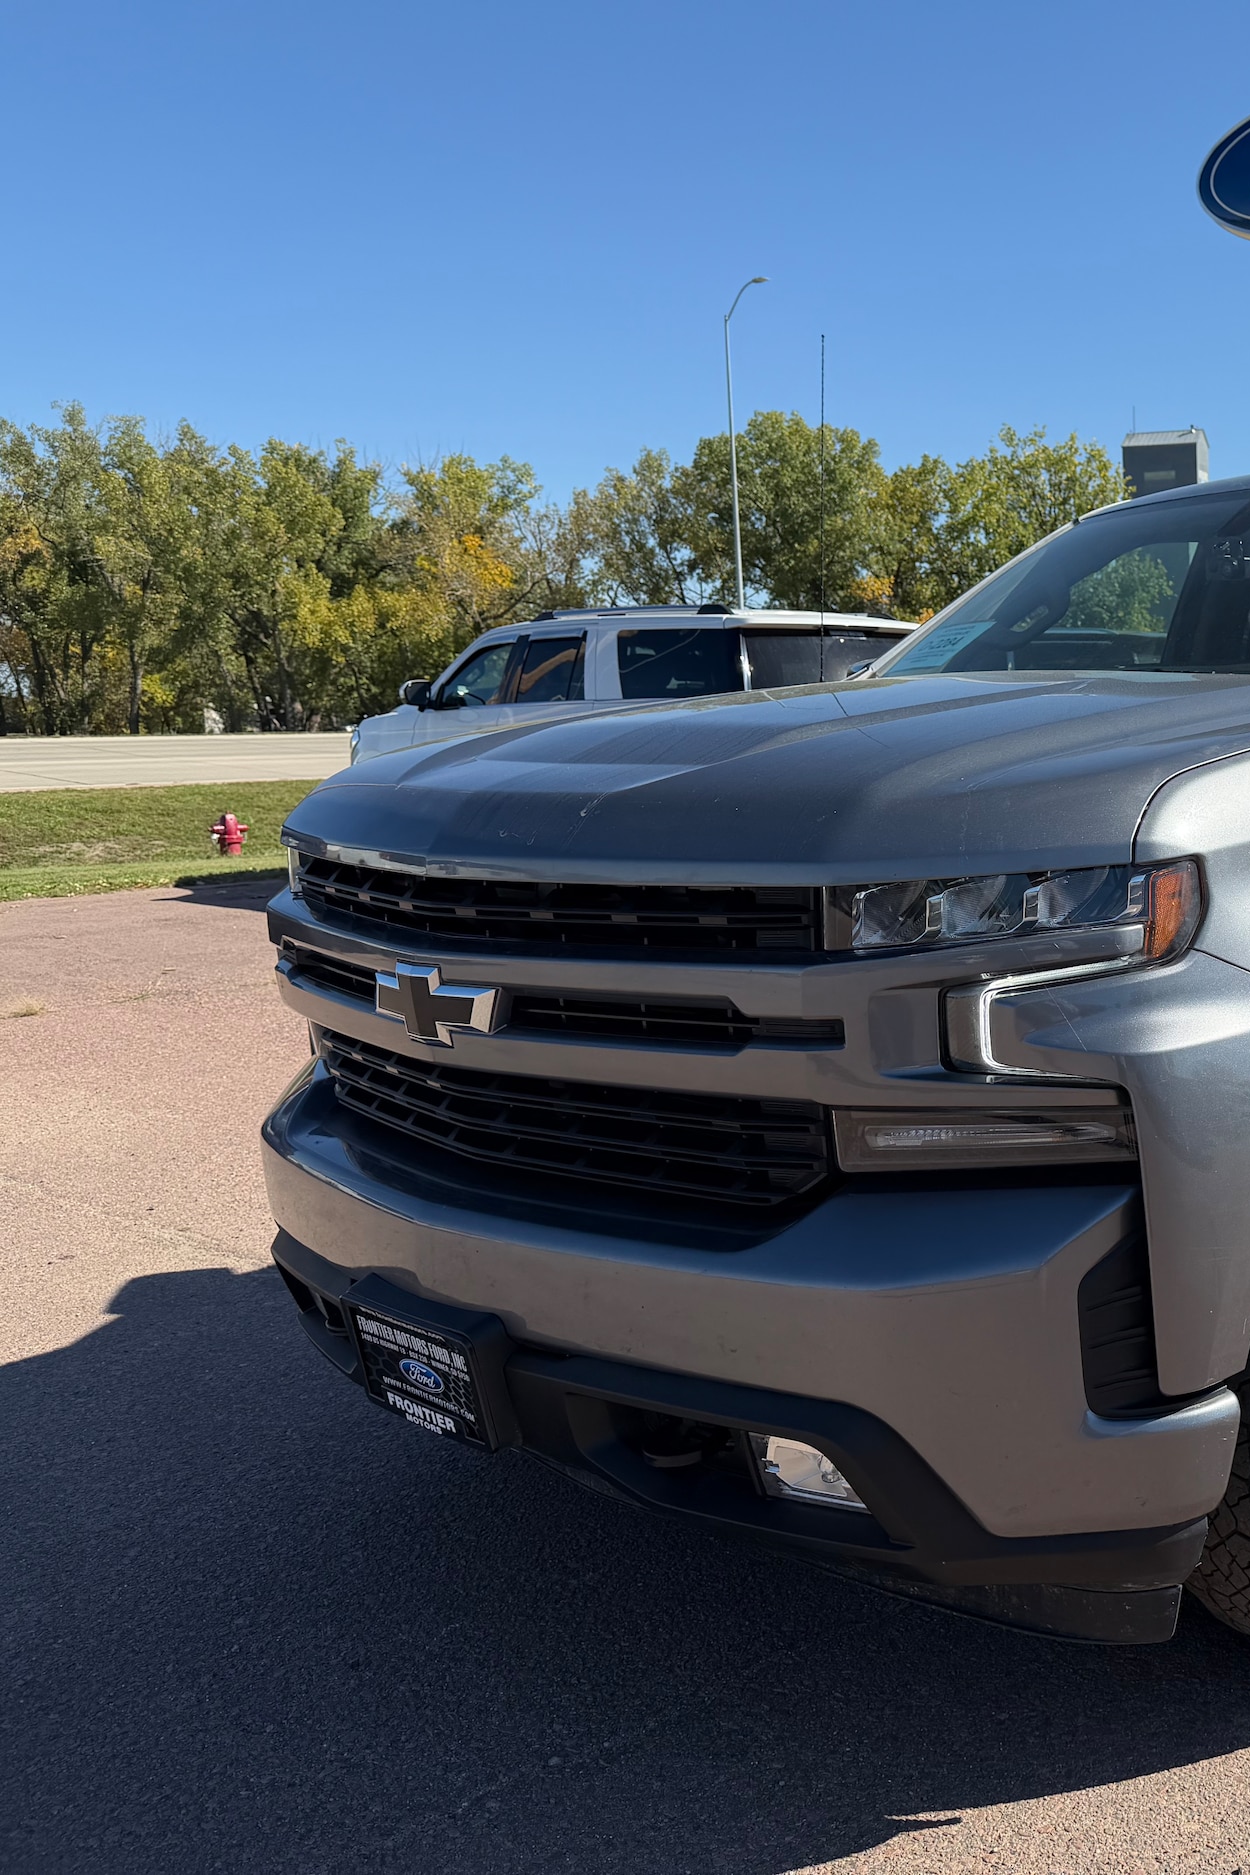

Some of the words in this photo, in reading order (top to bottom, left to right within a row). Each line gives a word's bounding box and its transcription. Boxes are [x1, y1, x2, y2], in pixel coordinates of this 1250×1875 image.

[356, 1315, 395, 1342] FRONTIER
[393, 1329, 429, 1356] MOTORS
[408, 1363, 437, 1389] Ford
[387, 1391, 457, 1434] FRONTIER
[405, 1412, 443, 1435] MOTORS
